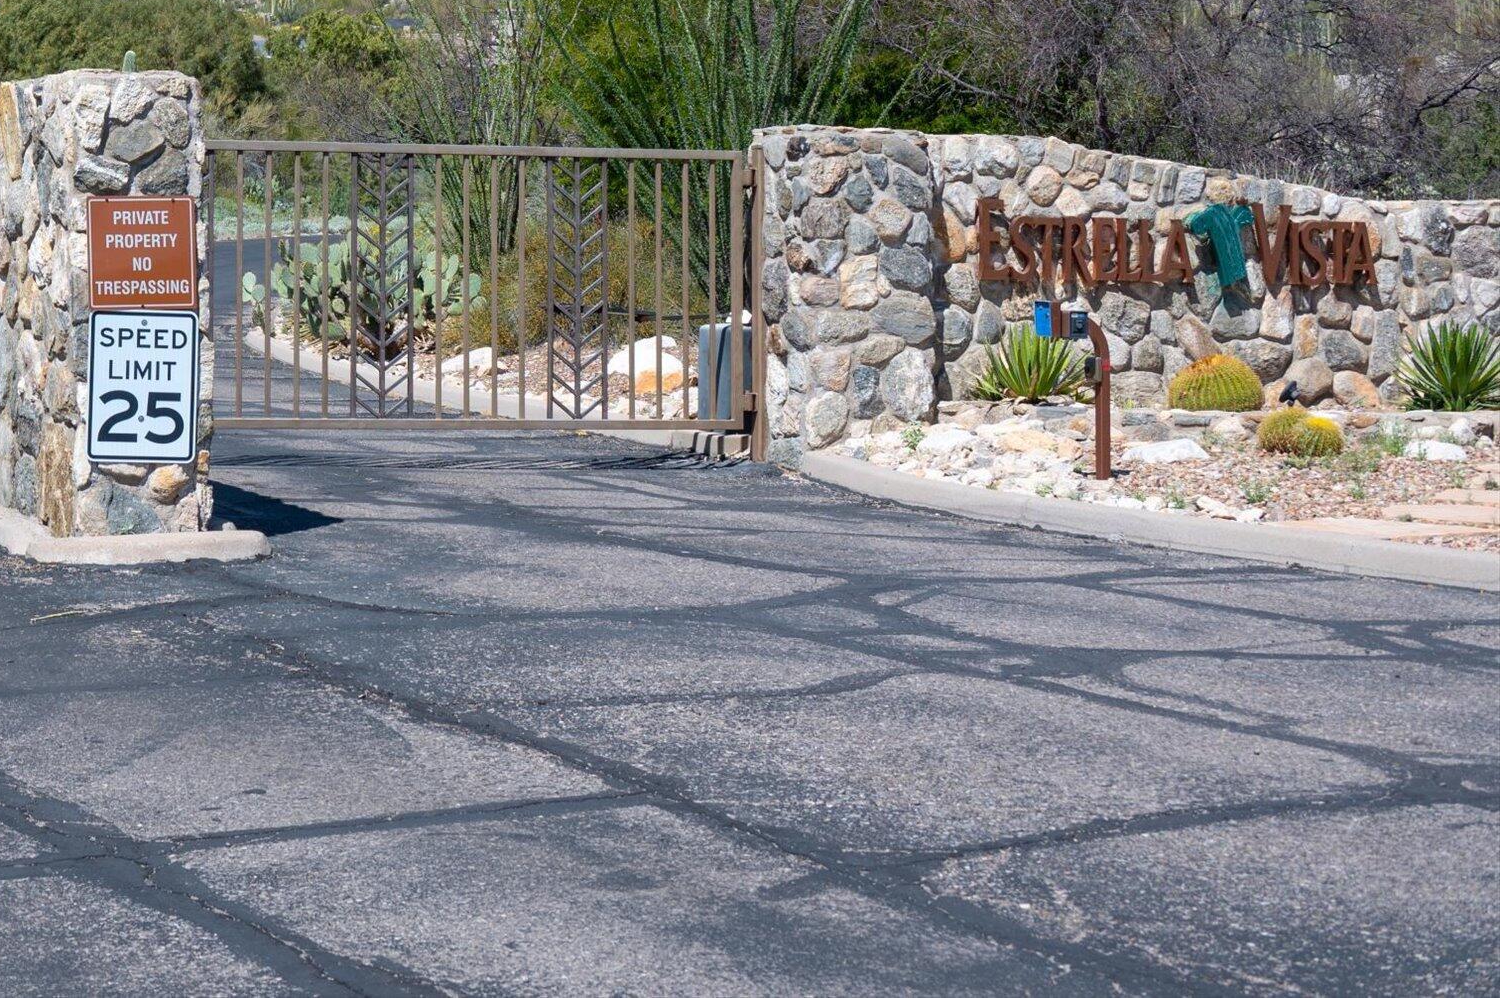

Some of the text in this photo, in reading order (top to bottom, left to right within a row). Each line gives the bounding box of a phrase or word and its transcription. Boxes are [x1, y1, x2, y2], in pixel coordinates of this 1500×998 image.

[112, 210, 169, 225] PRIVATE
[105, 233, 178, 248] PROPERTY
[976, 199, 1378, 286] ESTRELLA VISTA
[131, 256, 152, 272] NO
[95, 280, 190, 295] TRESPASSING
[99, 327, 188, 350] SPEED
[108, 359, 177, 381] LIMIT
[97, 390, 185, 444] 25
